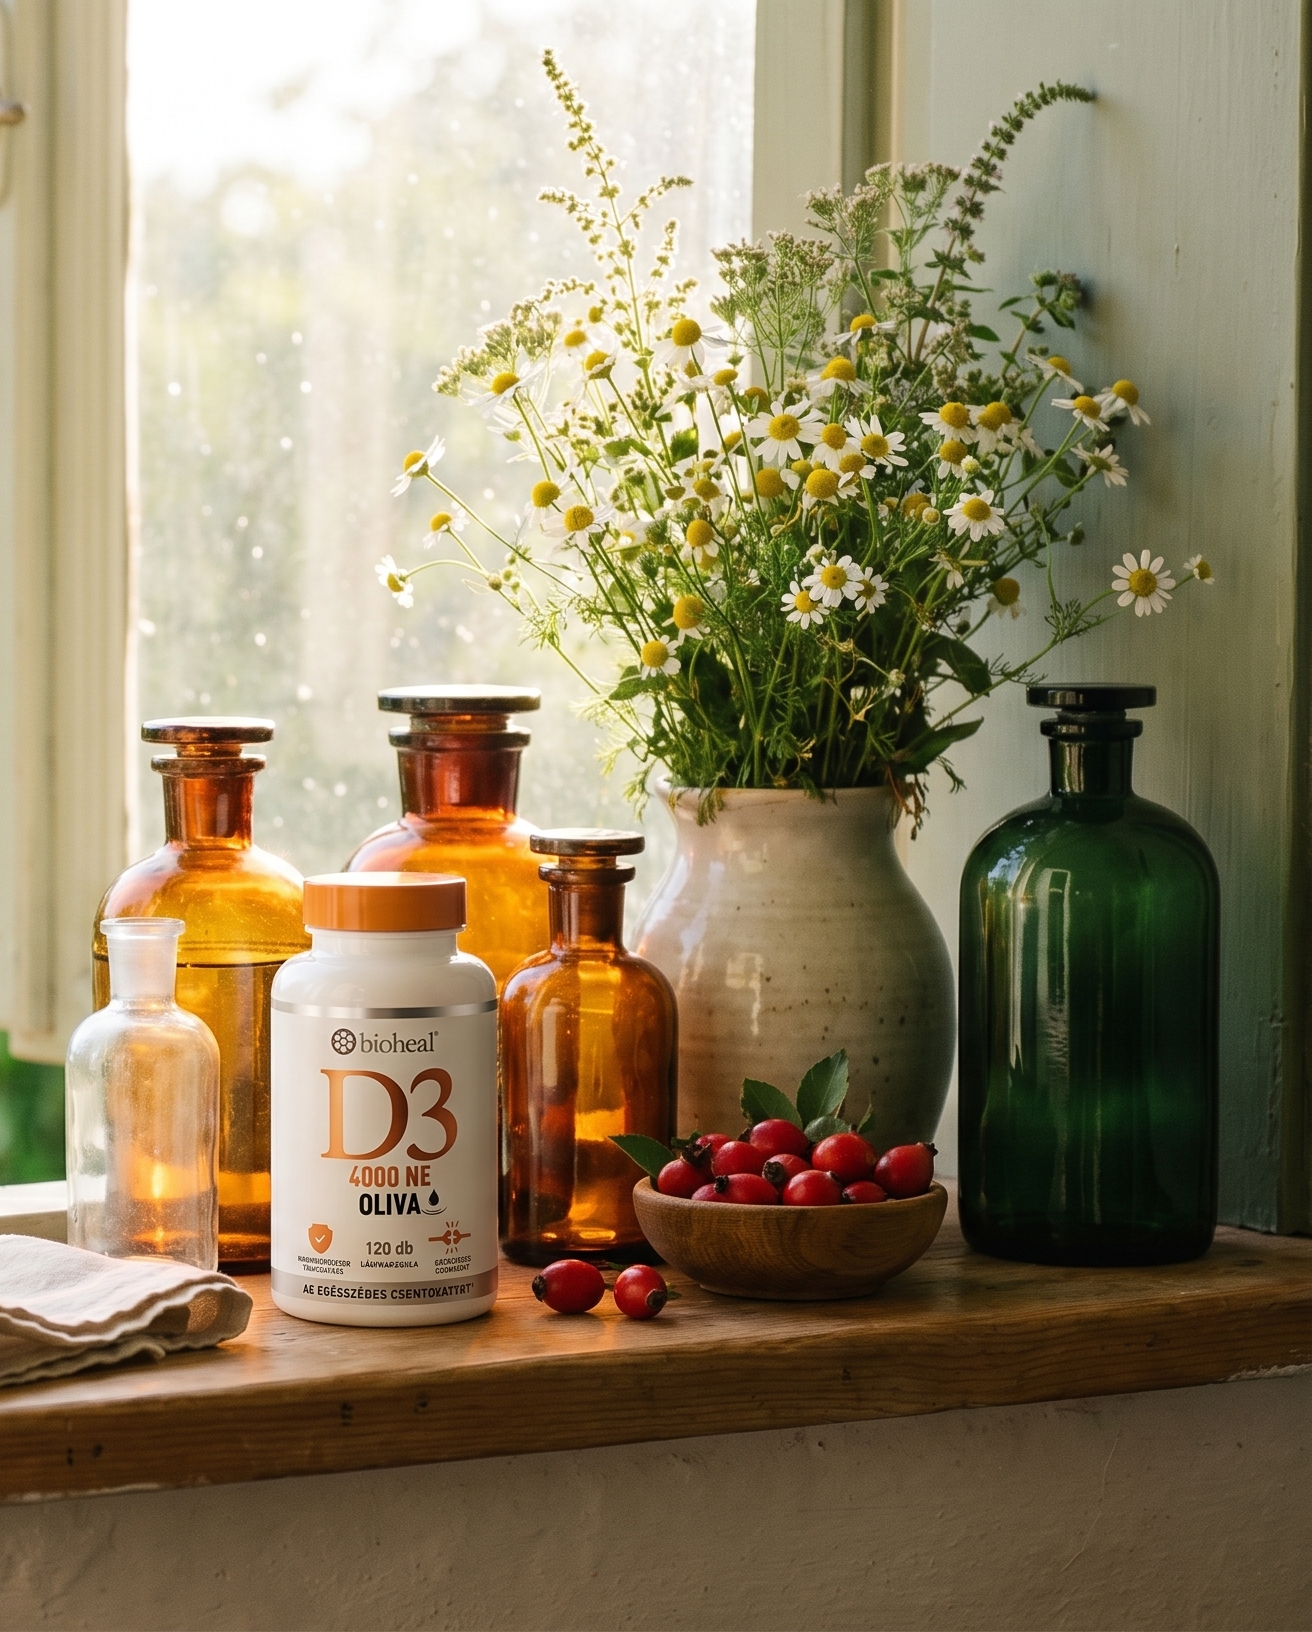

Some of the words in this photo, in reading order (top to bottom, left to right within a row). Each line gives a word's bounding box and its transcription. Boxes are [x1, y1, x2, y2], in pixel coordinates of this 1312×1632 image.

[320, 1067, 458, 1161] D3
[349, 1165, 399, 1187] 4000
[406, 1165, 431, 1187] NE
[359, 1193, 421, 1216] OLIVA
[366, 1241, 391, 1255] 120
[395, 1240, 414, 1255] db
